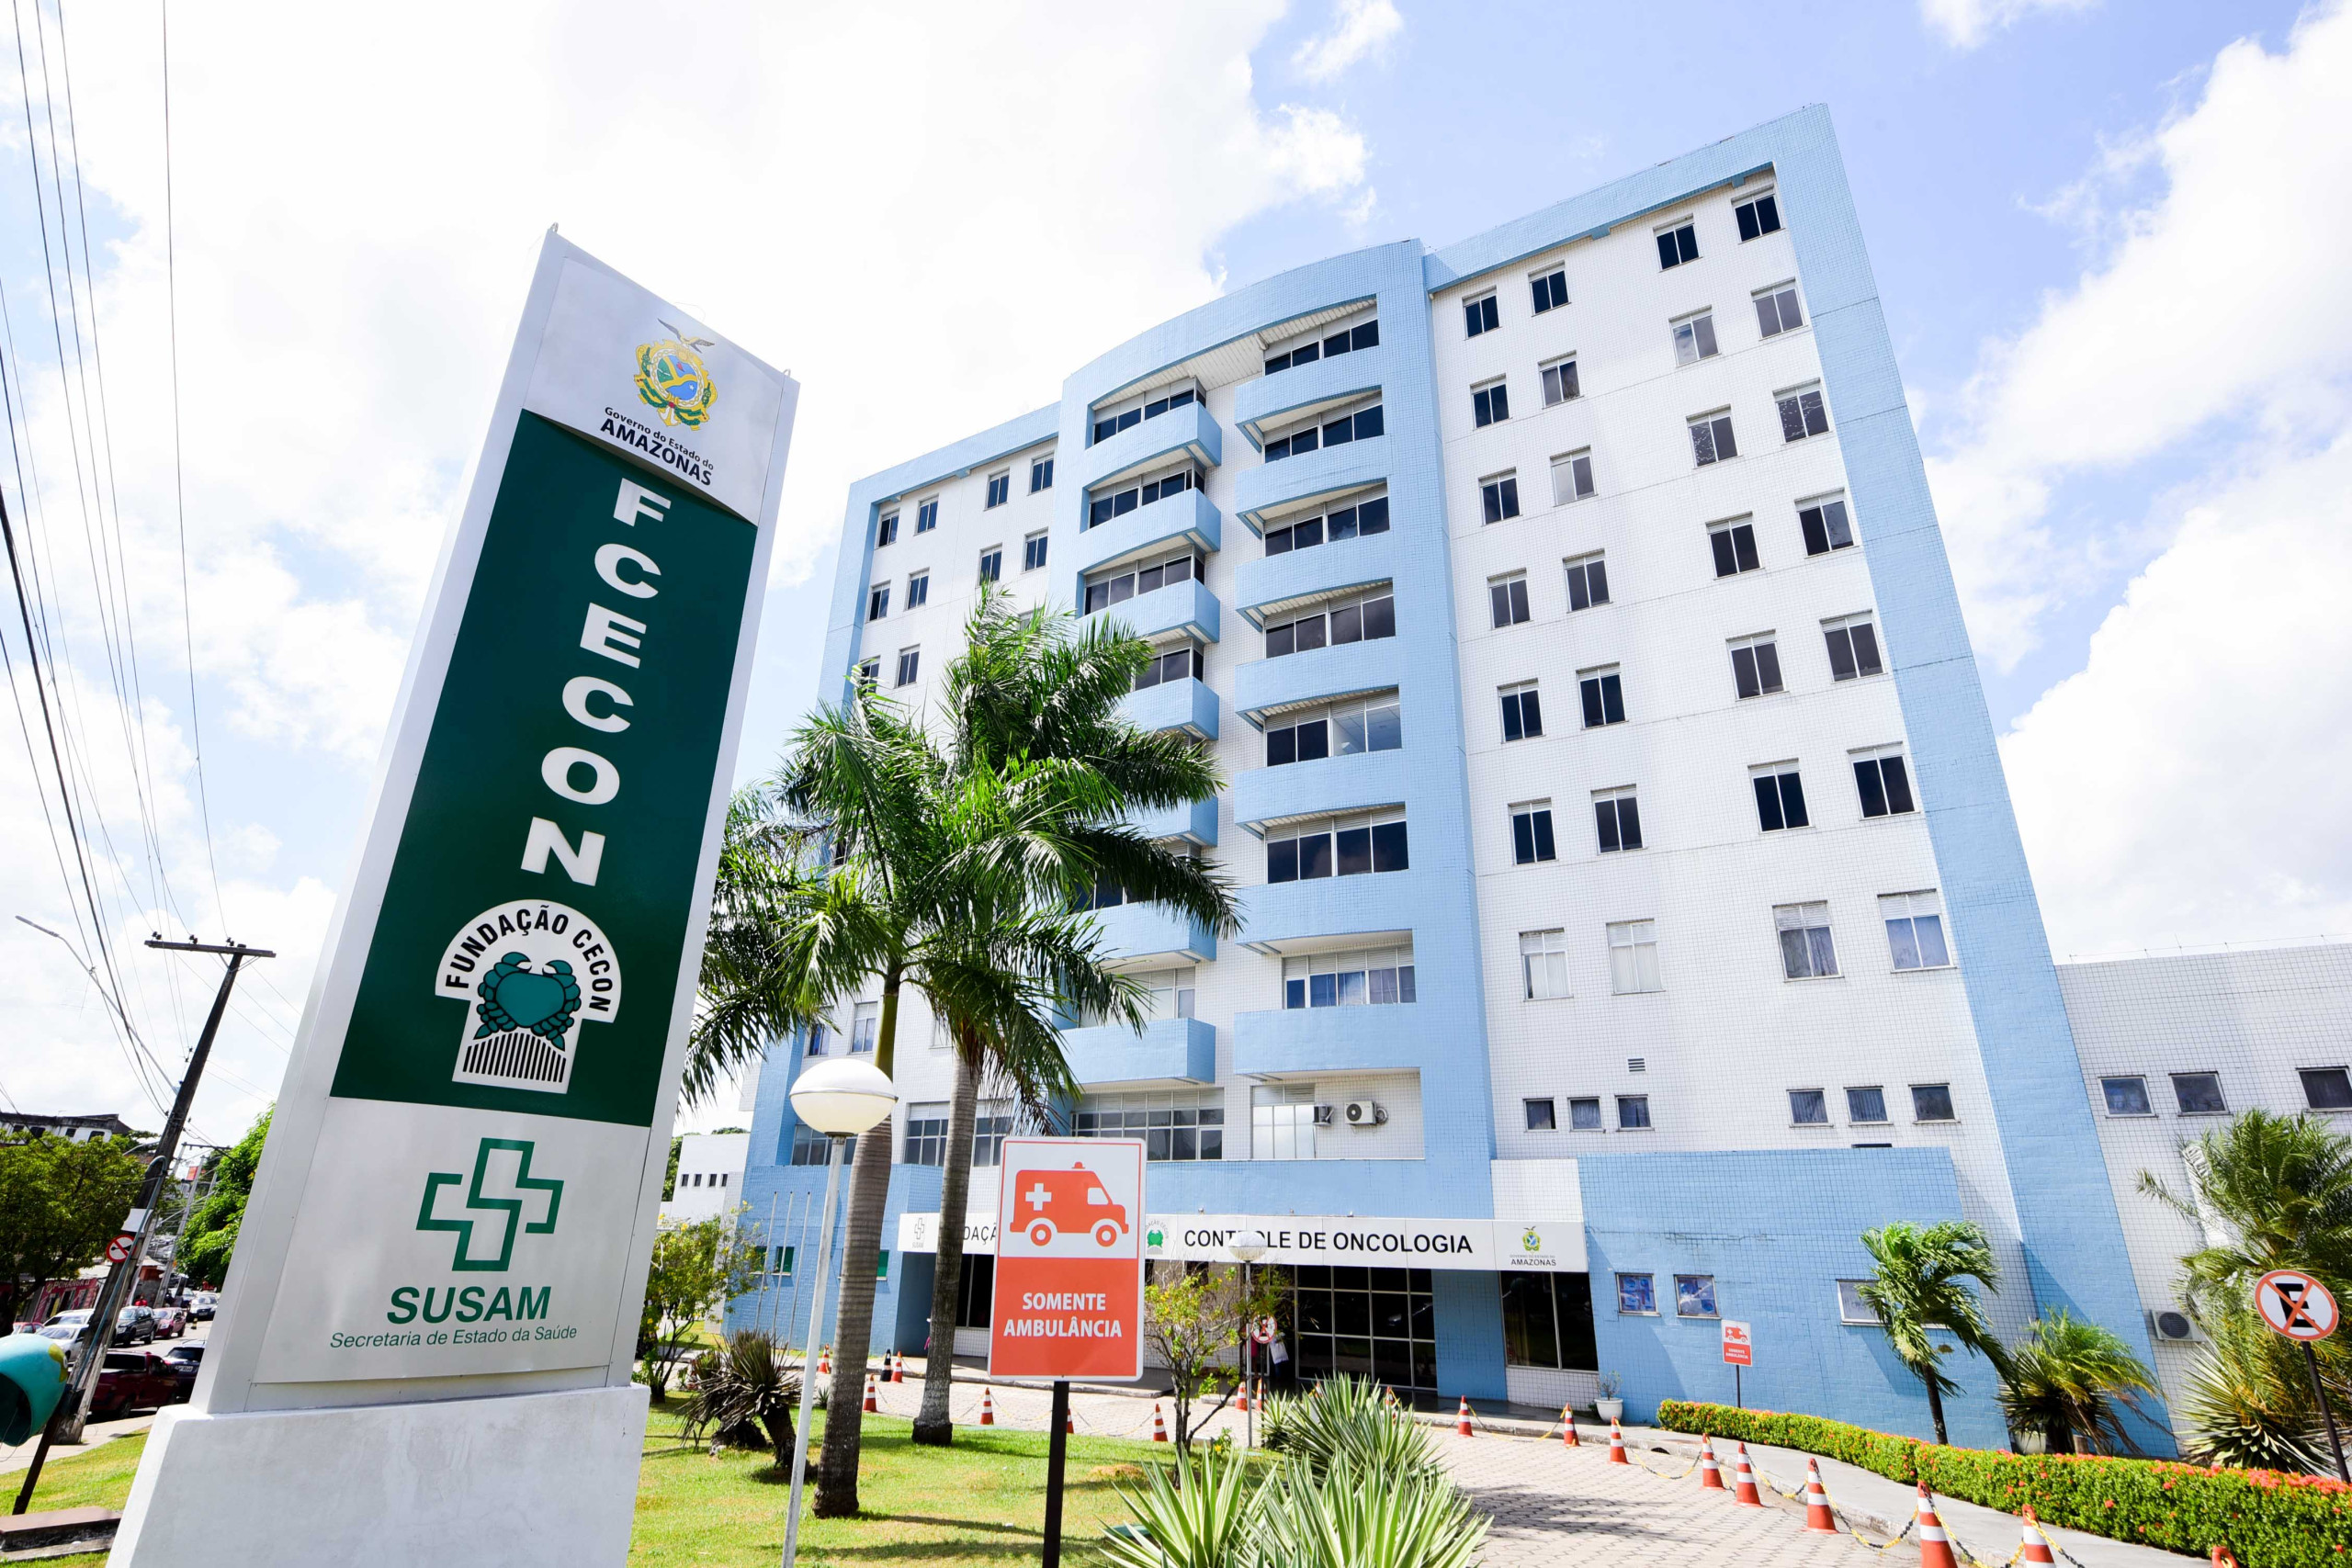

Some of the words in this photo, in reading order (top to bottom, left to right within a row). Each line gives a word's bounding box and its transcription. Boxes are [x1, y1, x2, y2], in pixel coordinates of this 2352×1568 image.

[600, 417, 712, 486] AMAZONAS
[605, 406, 651, 434] Governo
[653, 430, 666, 443] do
[668, 437, 701, 462] Estado
[702, 459, 714, 470] do
[520, 478, 672, 886] FCECON
[446, 904, 569, 988] FUNDAÇÃO
[571, 929, 613, 1012] CECON
[962, 1222, 996, 1246] DAÇÃ
[1184, 1229, 1291, 1248] CONTLE
[1299, 1231, 1327, 1249] DE
[1333, 1232, 1473, 1254] ONCOLOGIA
[1510, 1258, 1556, 1267] AMAZONAS
[387, 1285, 551, 1325] SUSAM
[1022, 1292, 1106, 1311] SOMENTE
[2275, 1282, 2315, 1328] E
[330, 1331, 421, 1348] Secretaria
[426, 1330, 447, 1346] de
[452, 1329, 507, 1345] Estado
[511, 1327, 530, 1342] da
[534, 1325, 578, 1341] Saúde
[1003, 1315, 1123, 1338] AMBULÂNCIA
